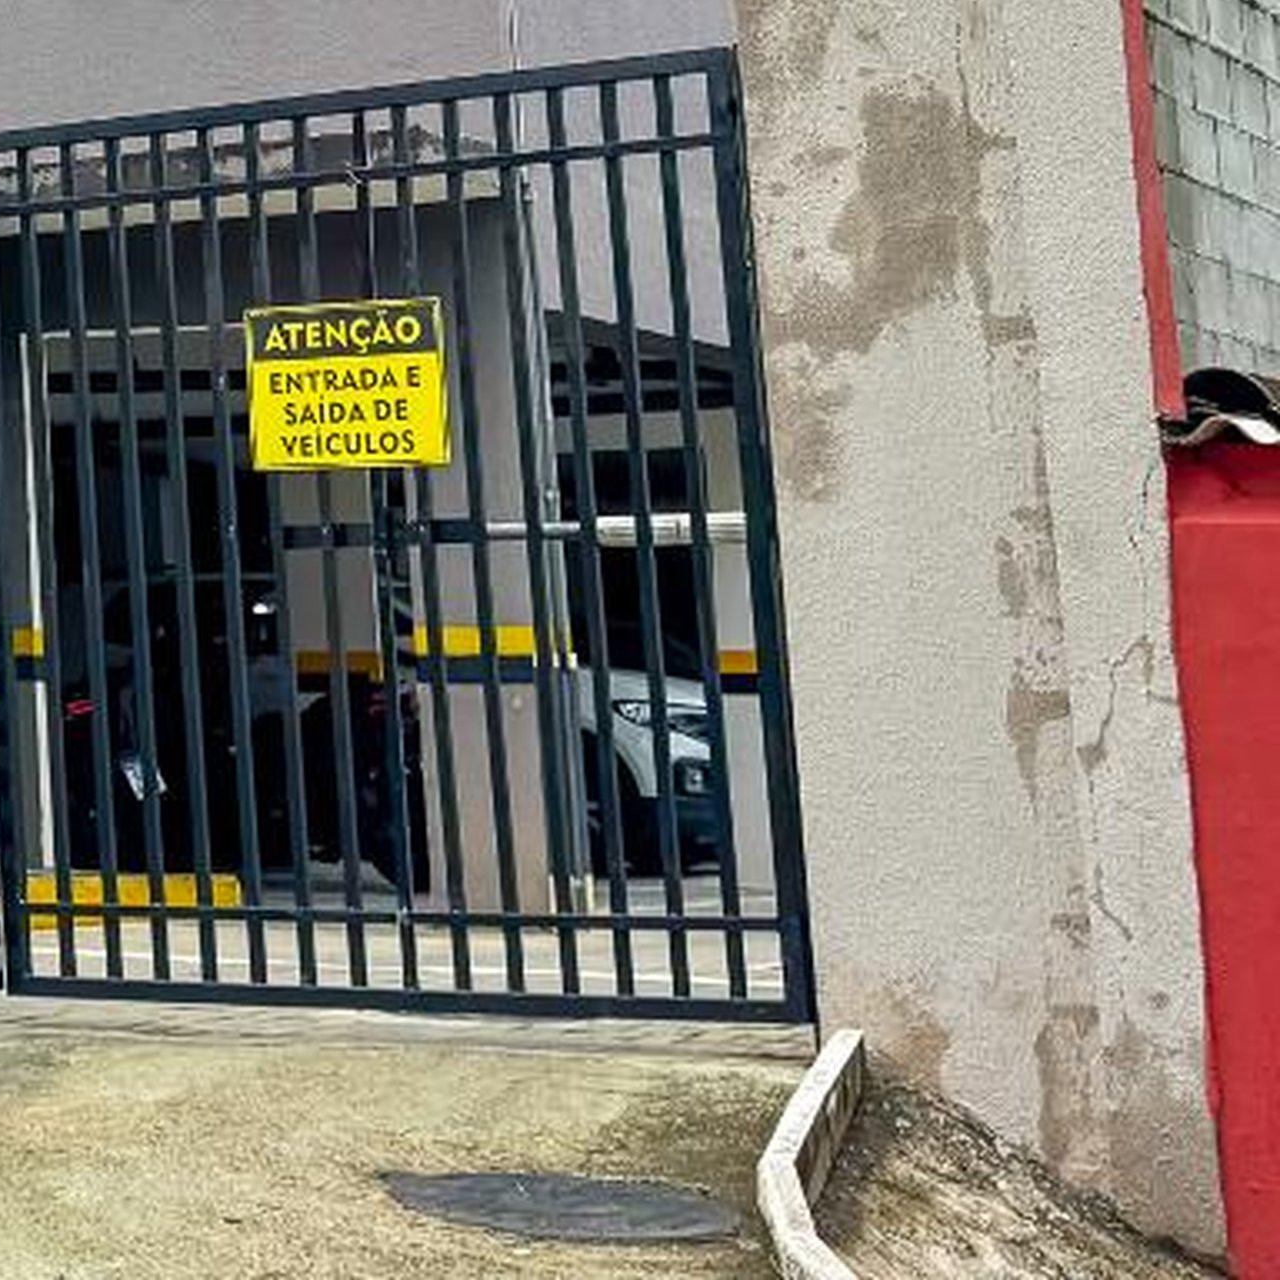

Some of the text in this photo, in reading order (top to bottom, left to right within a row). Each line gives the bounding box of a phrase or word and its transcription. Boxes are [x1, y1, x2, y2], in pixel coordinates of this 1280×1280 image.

[265, 309, 422, 354] ATENÇÃO
[269, 366, 421, 395] ENTRADA E
[283, 395, 409, 426] SAÍDA DE
[280, 427, 416, 458] VEÍCULOS
